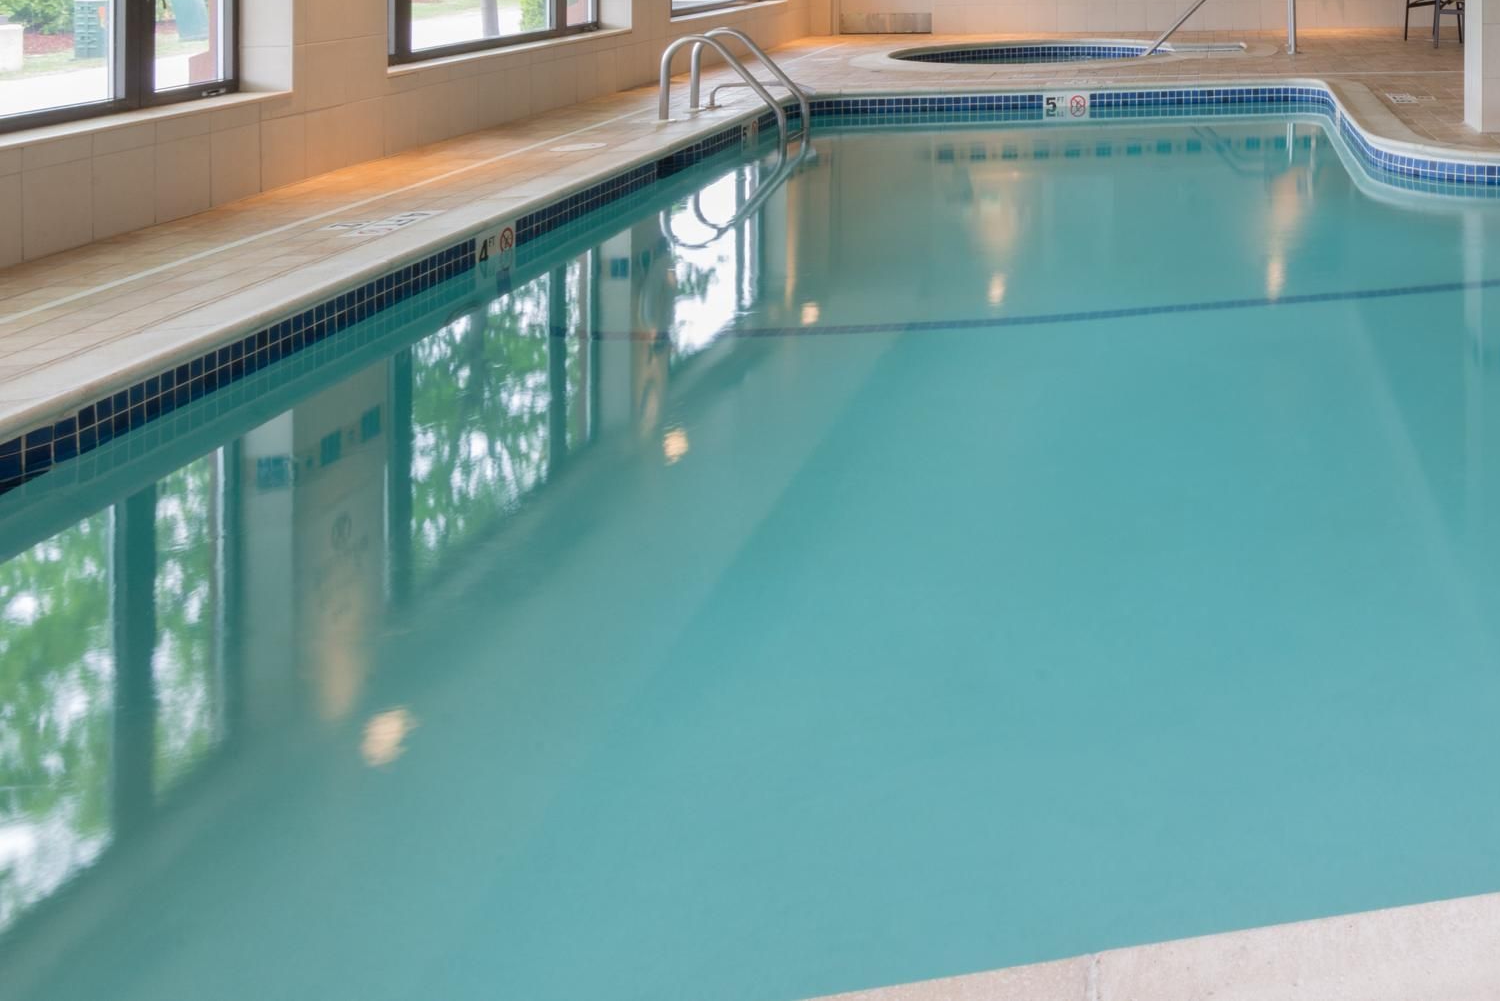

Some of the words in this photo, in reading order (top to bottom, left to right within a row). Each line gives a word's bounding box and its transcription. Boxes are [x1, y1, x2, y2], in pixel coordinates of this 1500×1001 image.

[1046, 97, 1057, 112] 5
[479, 239, 489, 263] 4
[489, 235, 496, 248] FT
